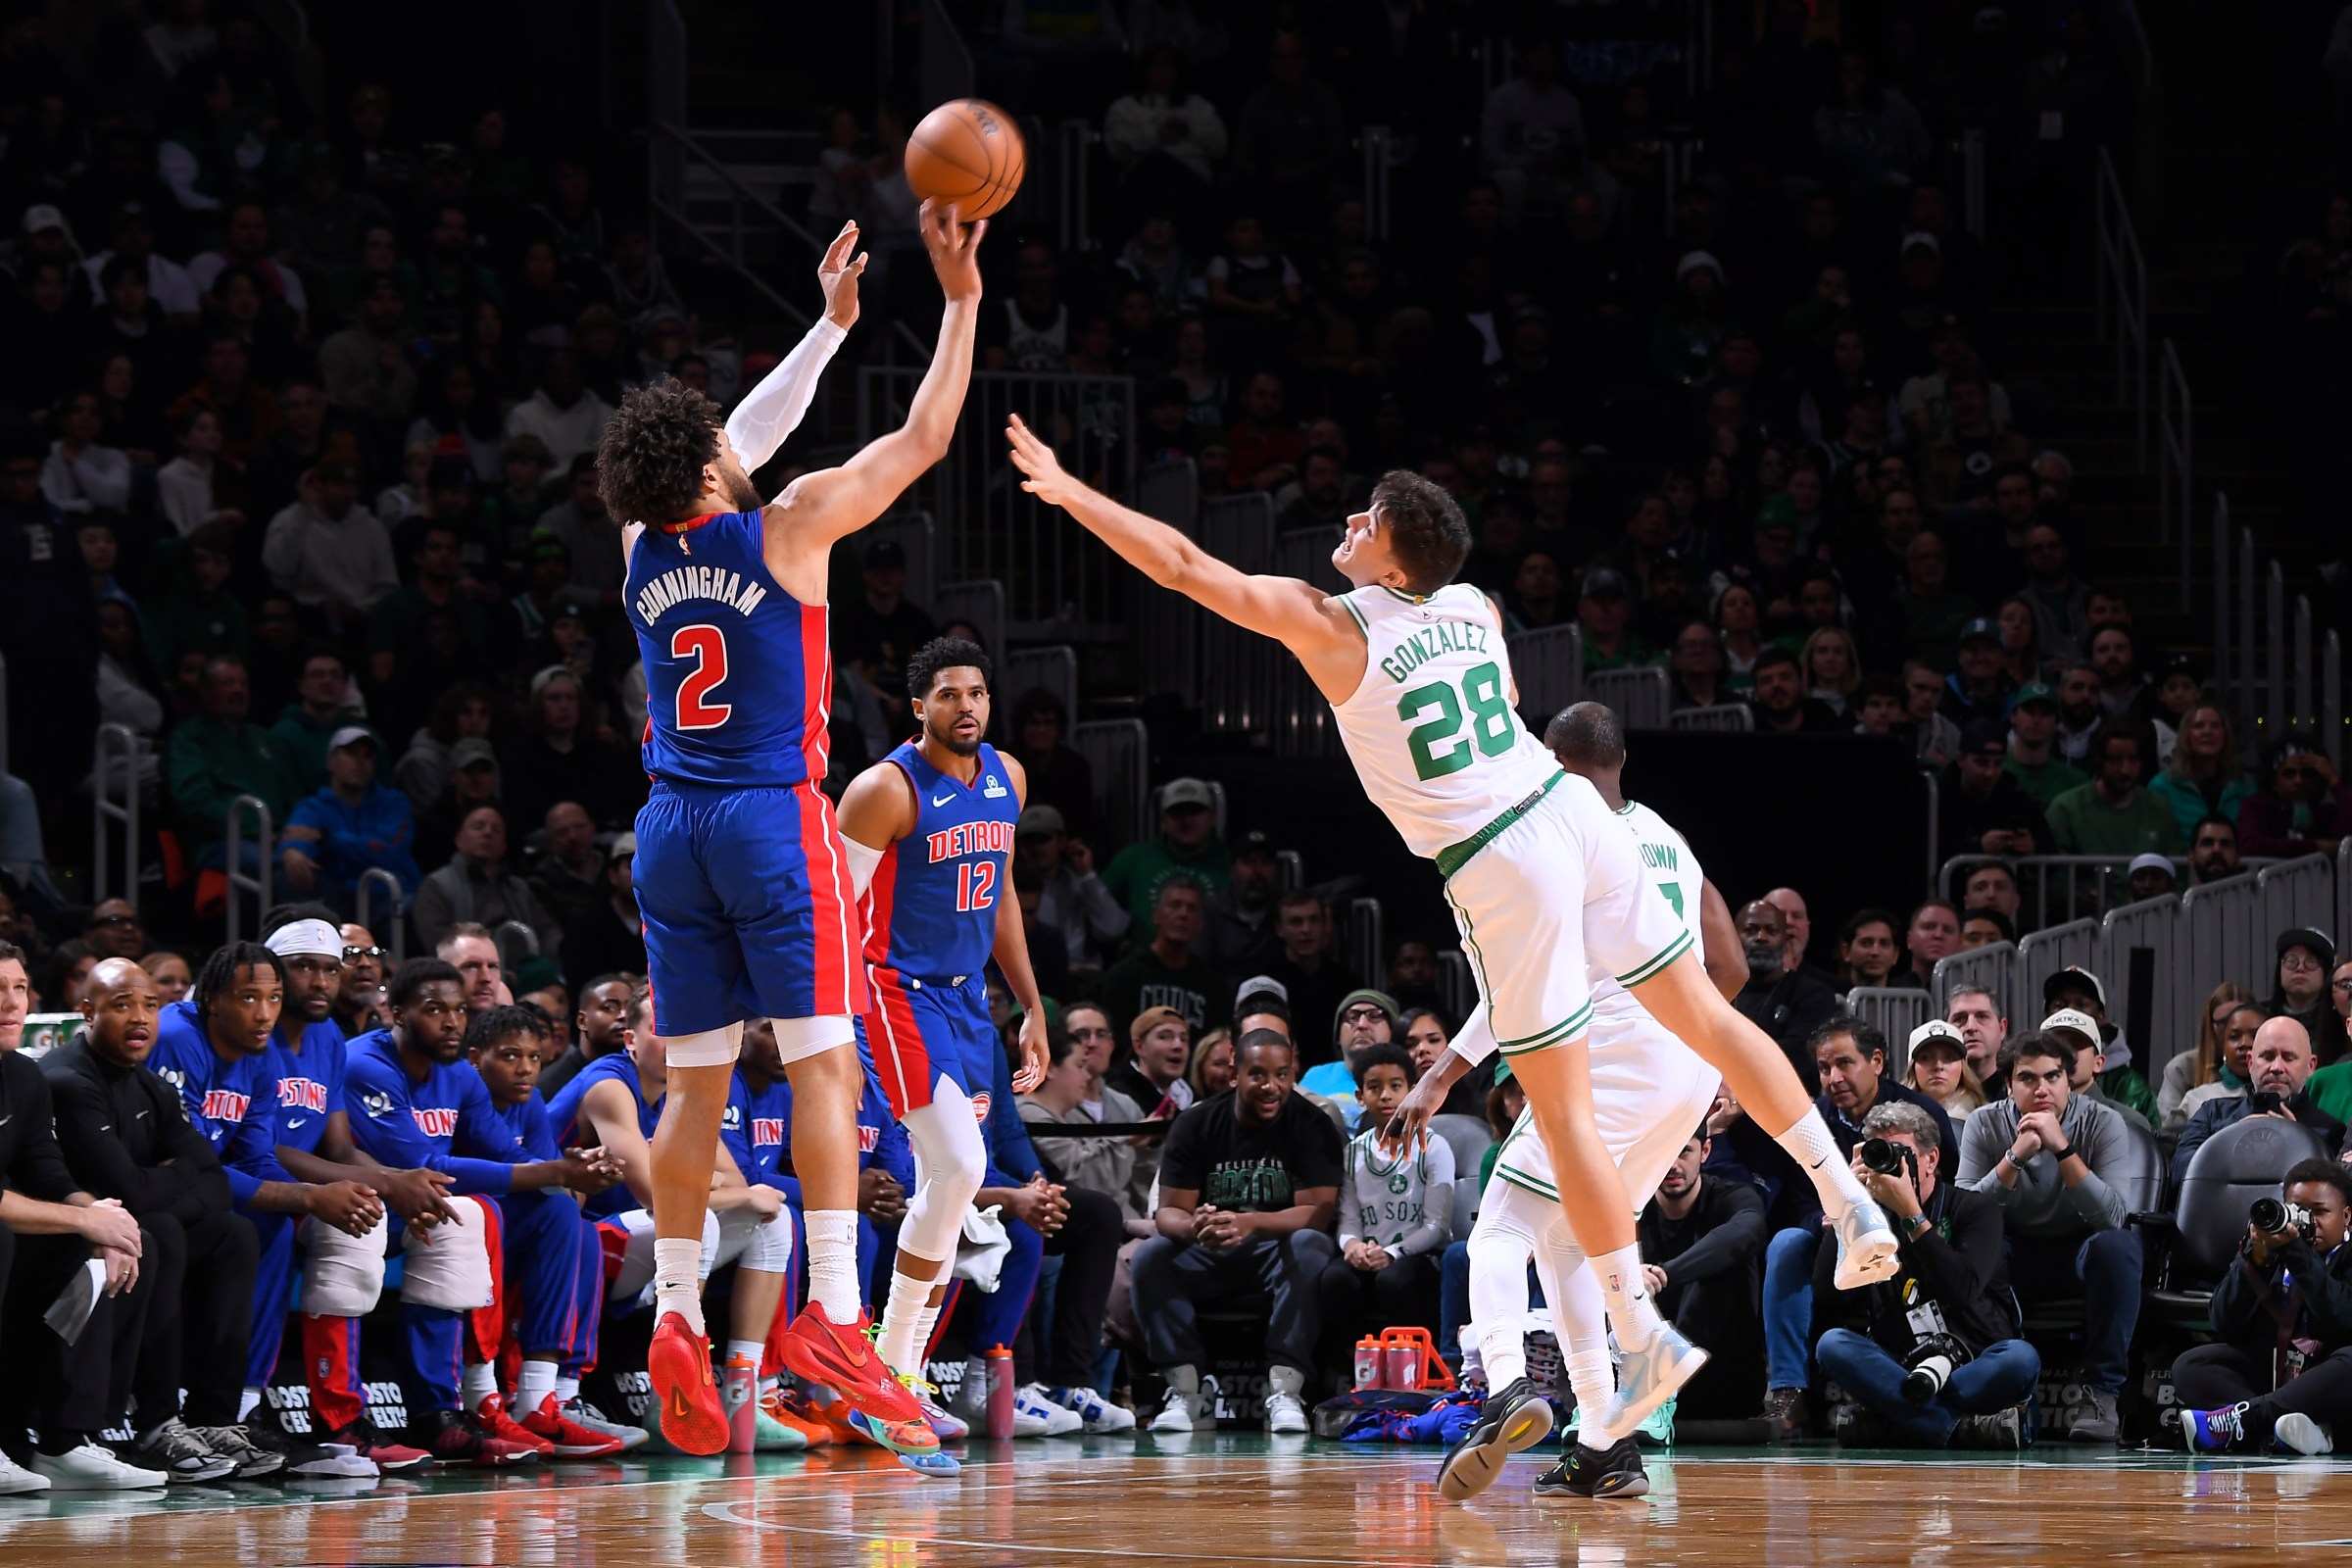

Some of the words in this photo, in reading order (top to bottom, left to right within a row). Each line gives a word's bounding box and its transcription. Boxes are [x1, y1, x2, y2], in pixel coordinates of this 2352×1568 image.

[636, 565, 766, 627] CUNNINGHAM
[671, 623, 732, 730] 2
[1396, 661, 1515, 782] 28
[926, 820, 1016, 863] DETROIT
[956, 860, 997, 912] 12
[1656, 881, 1685, 922] 7
[1385, 1200, 1422, 1223] SOX
